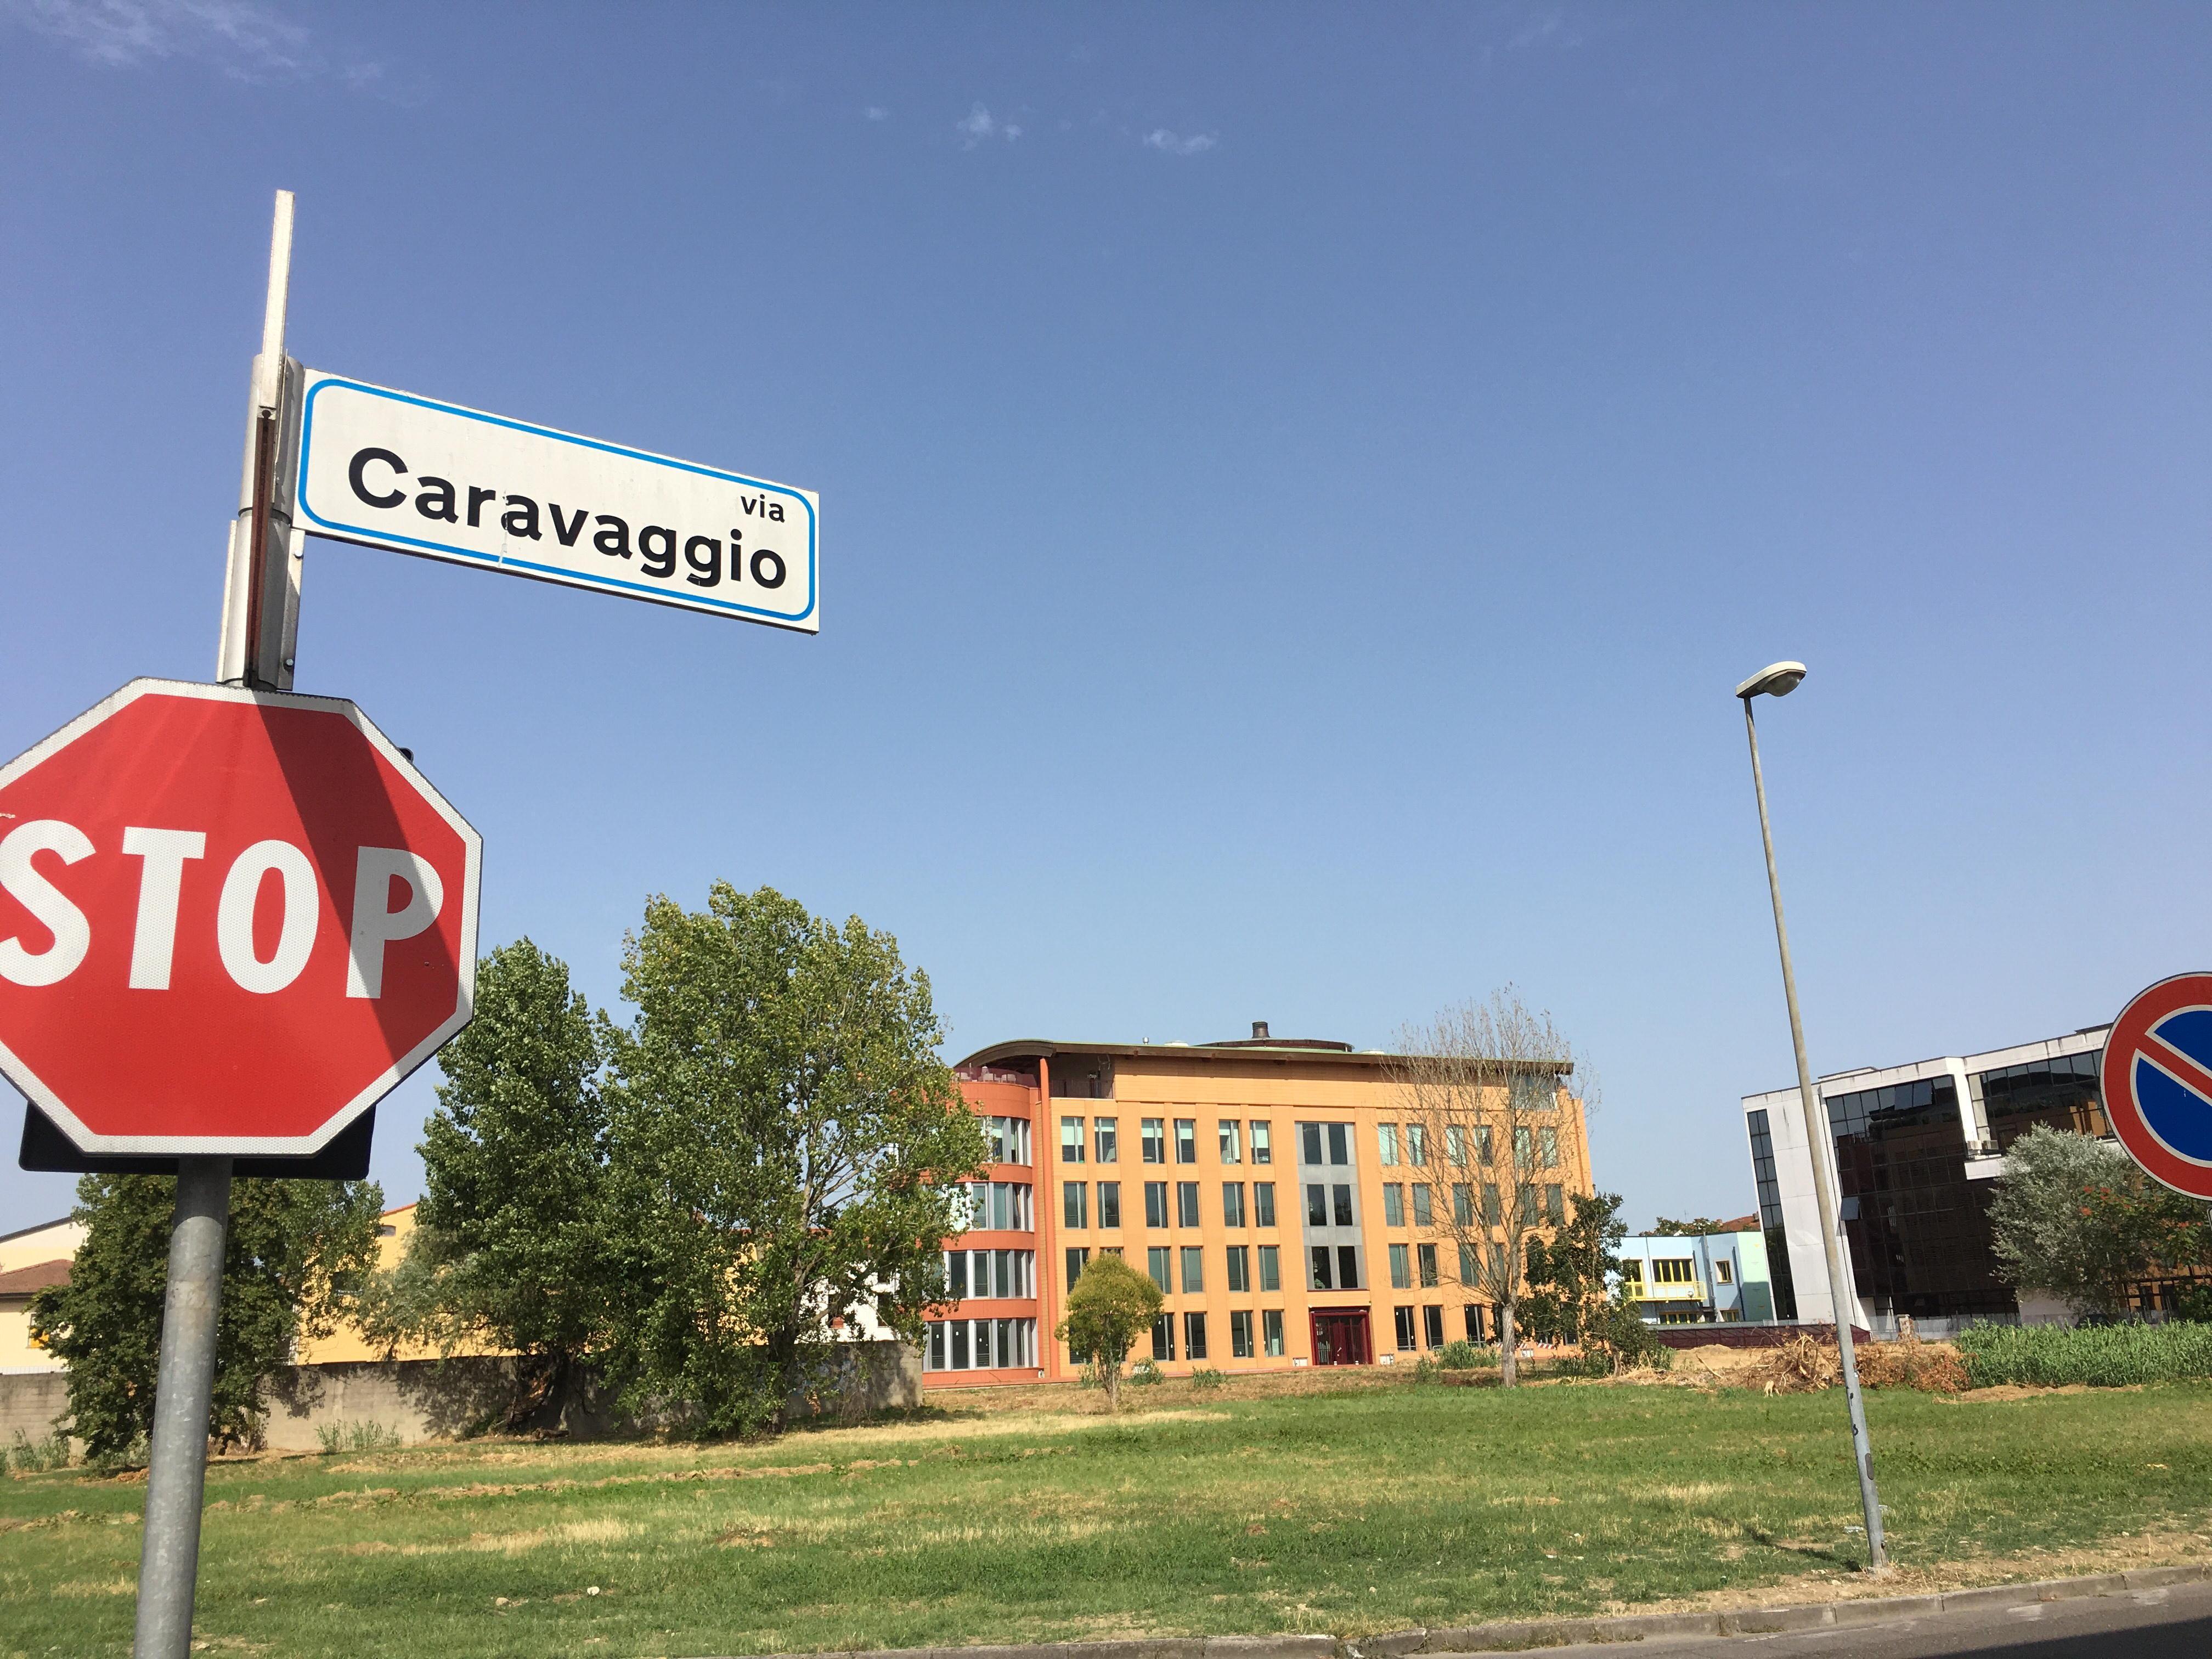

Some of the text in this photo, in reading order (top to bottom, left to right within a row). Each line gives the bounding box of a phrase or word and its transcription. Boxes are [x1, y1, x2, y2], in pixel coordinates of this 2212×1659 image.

[348, 447, 787, 588] Caravaggio
[740, 494, 786, 523] via
[0, 818, 444, 999] STOP
